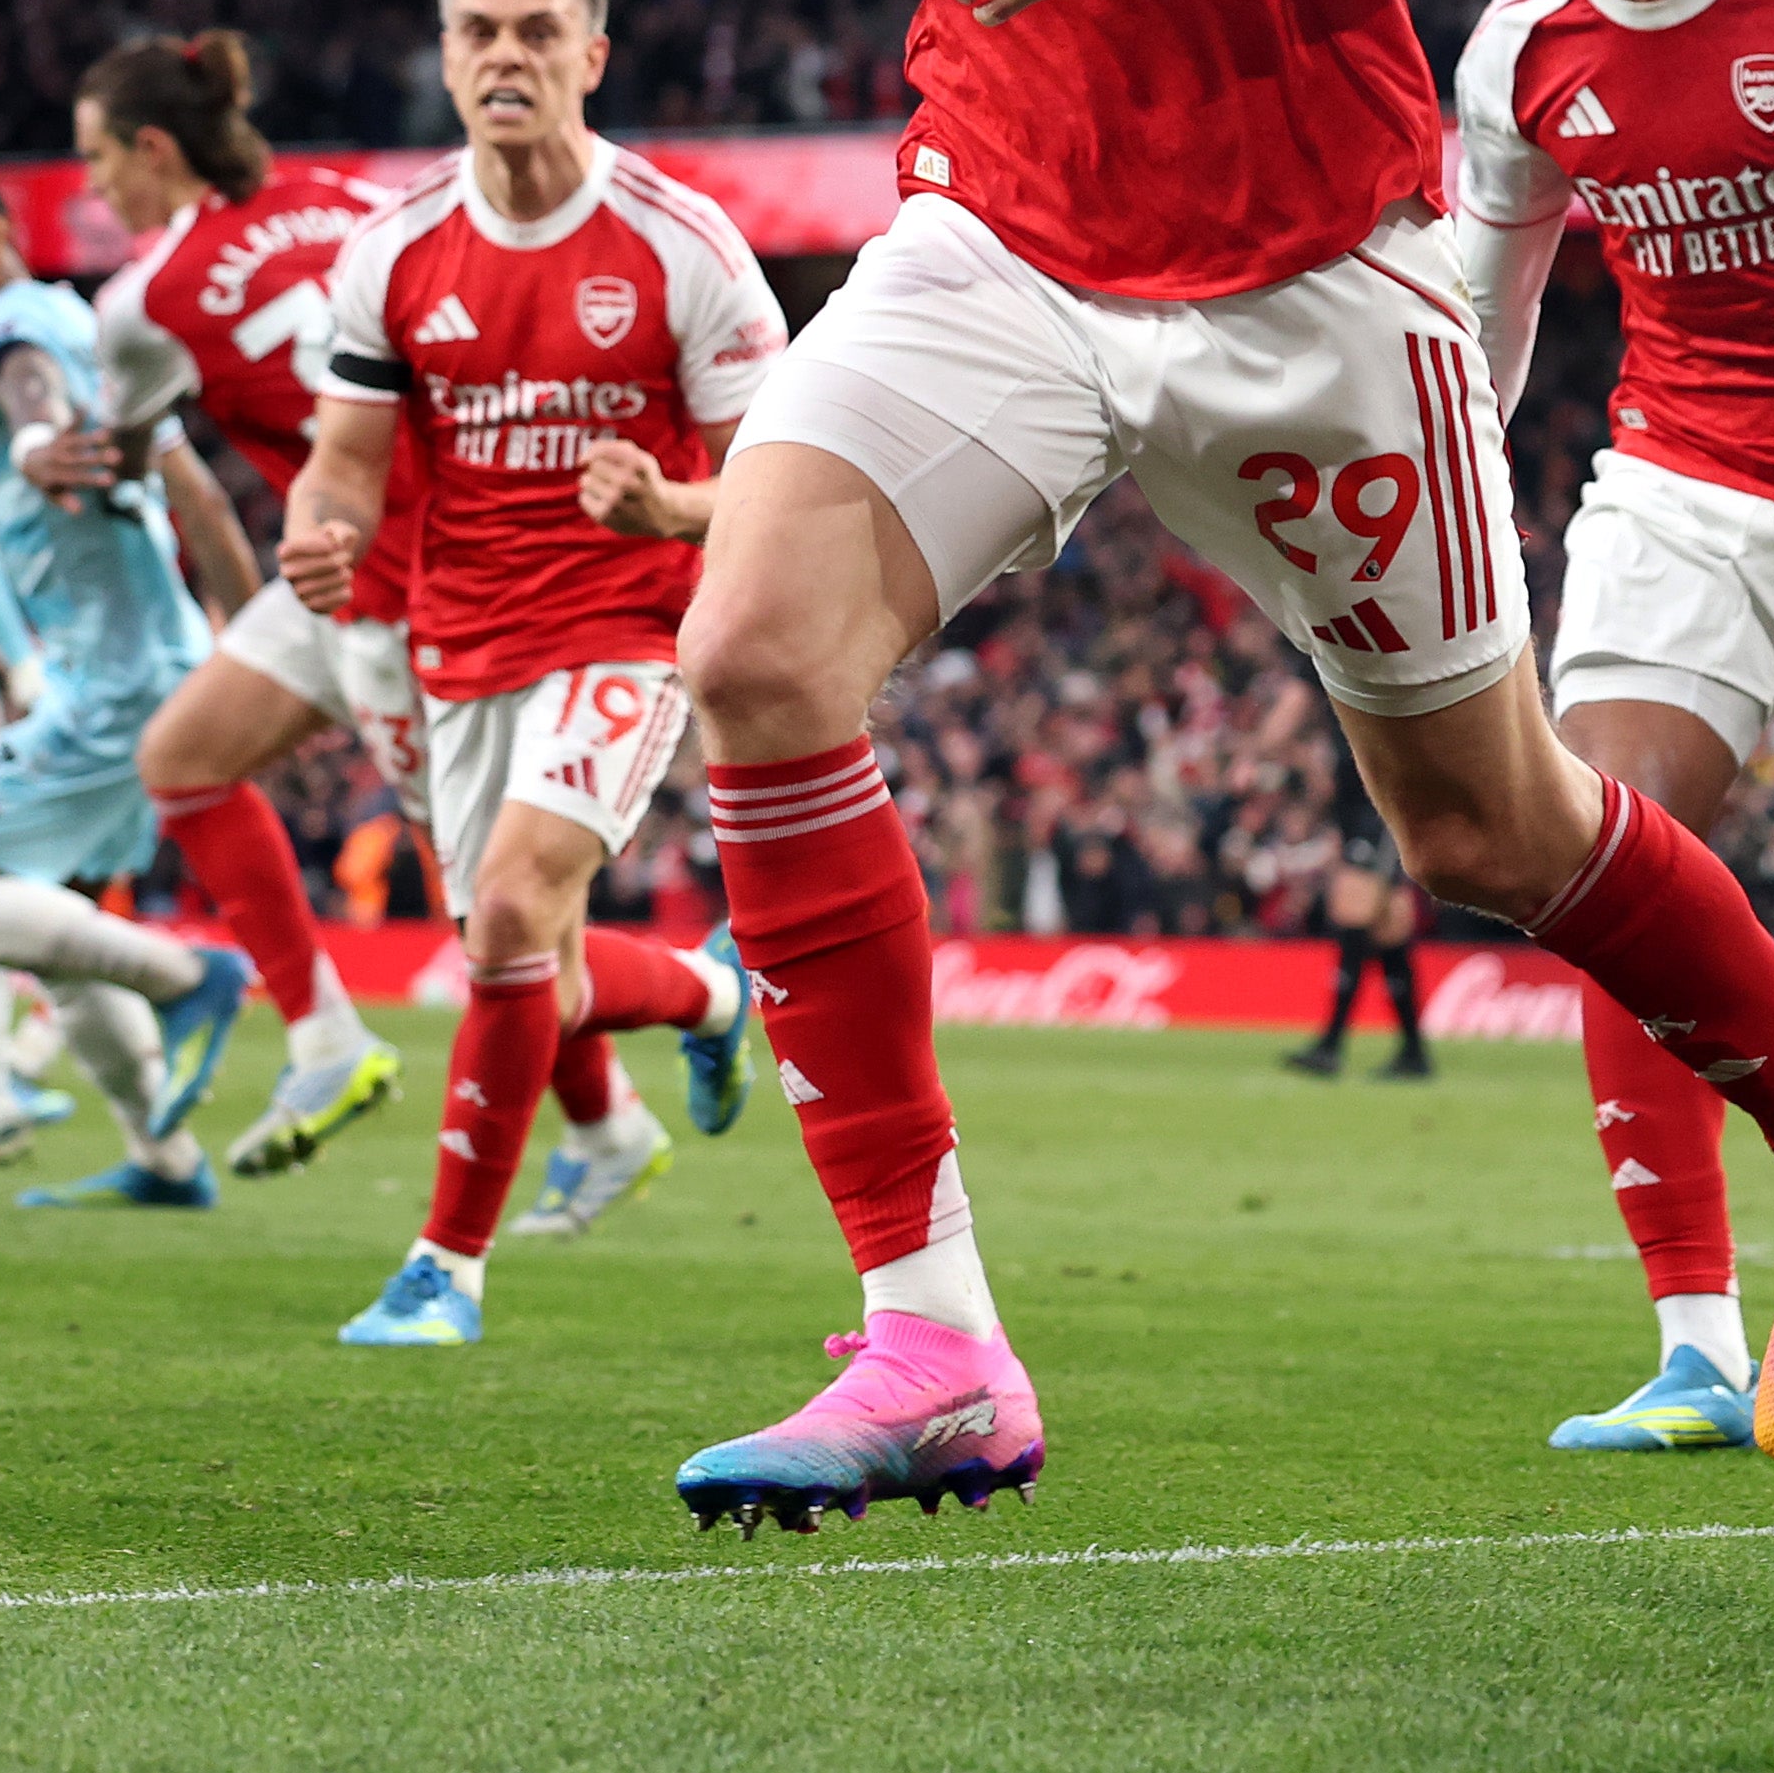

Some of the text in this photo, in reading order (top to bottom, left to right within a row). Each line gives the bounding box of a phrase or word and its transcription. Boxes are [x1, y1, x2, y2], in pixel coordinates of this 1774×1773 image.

[426, 369, 648, 425] Emirates
[504, 424, 618, 471] BETTE
[1237, 451, 1421, 582] 29
[555, 668, 646, 749] 19
